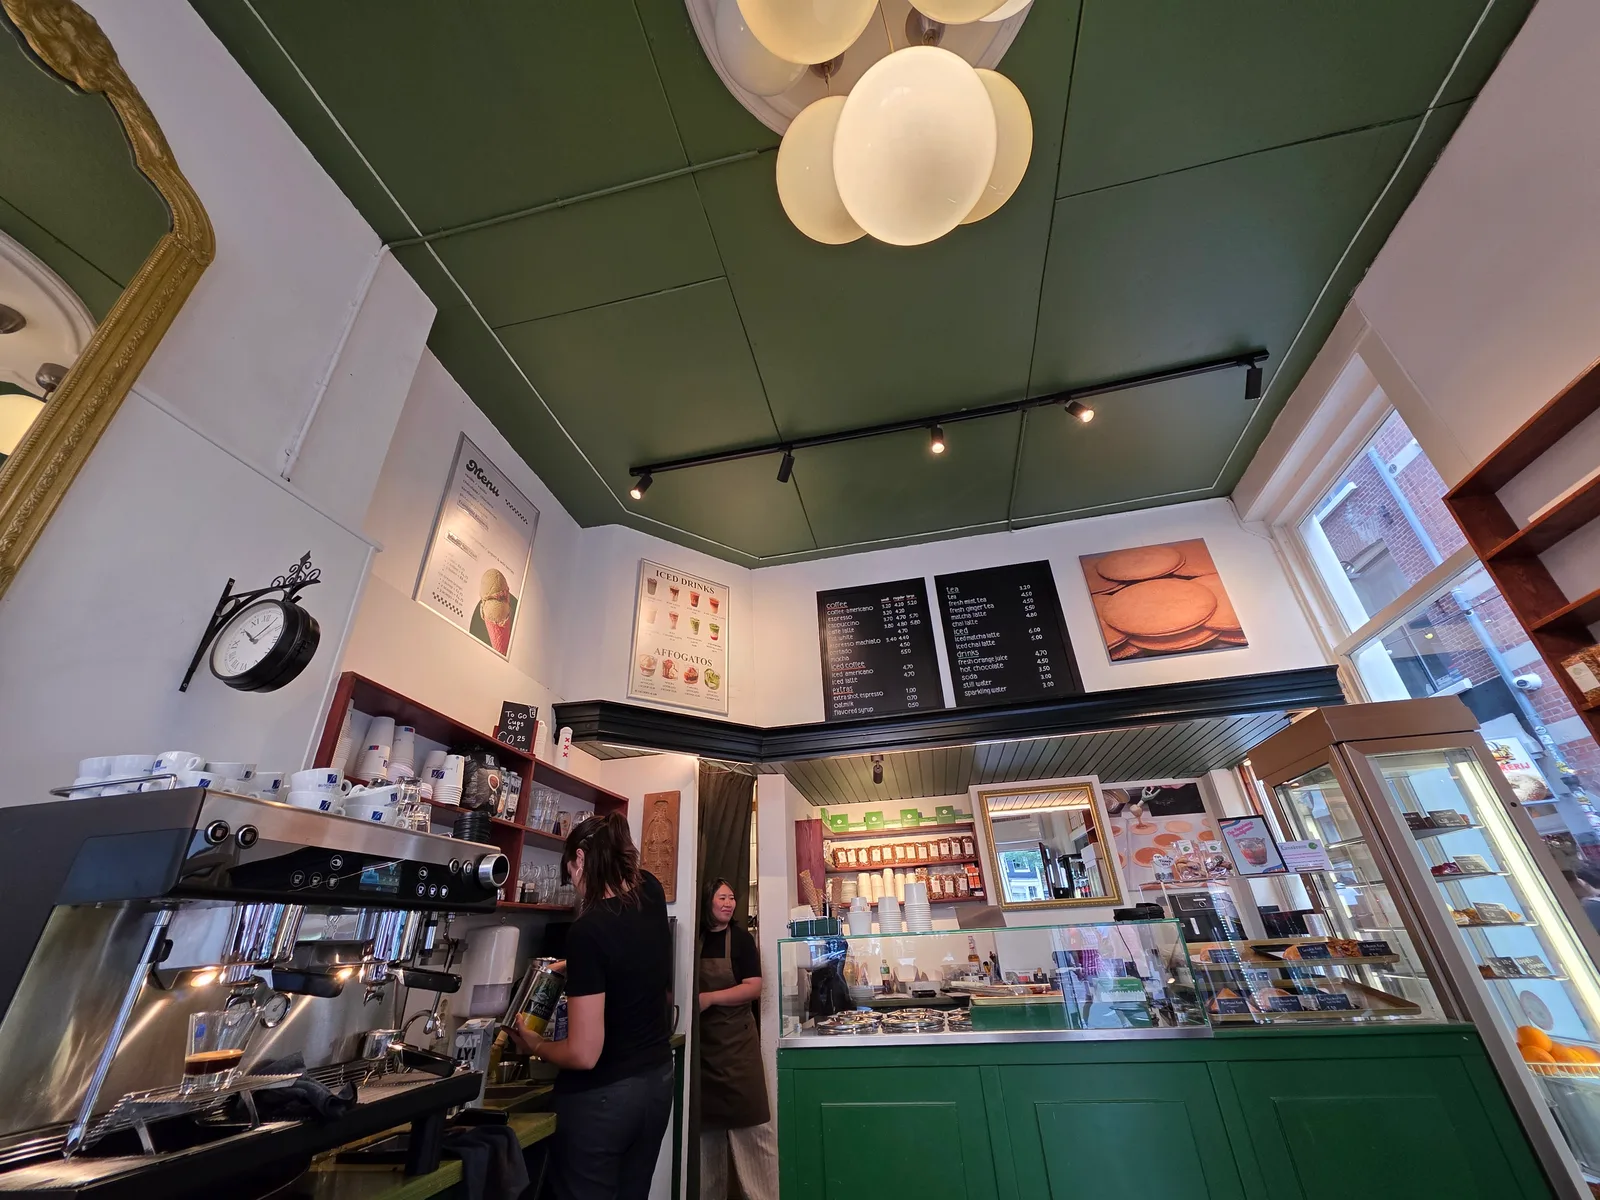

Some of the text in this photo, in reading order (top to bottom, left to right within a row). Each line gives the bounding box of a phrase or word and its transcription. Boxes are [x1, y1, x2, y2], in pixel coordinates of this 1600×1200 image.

[466, 459, 500, 497] Menu
[656, 569, 715, 594] ICED DRINKS
[950, 606, 965, 614] fresh
[966, 604, 984, 612] ginger
[951, 612, 972, 620] matcha
[972, 610, 987, 618] latte
[952, 620, 964, 628] chai
[953, 627, 968, 635] iced
[986, 631, 1000, 639] latte
[654, 648, 713, 667] AFFOGATOS
[958, 658, 974, 666] fresh
[994, 654, 1008, 662] juice
[831, 662, 844, 670] iced
[960, 665, 972, 673] hot
[973, 662, 1004, 672] chocolate
[961, 673, 978, 681] soda
[963, 681, 974, 689] still
[859, 691, 884, 699] espresso
[964, 687, 991, 697] sparkling
[505, 710, 515, 718] To
[858, 706, 874, 714] syrup
[507, 718, 524, 727] Cups
[457, 1047, 476, 1060] LY!
